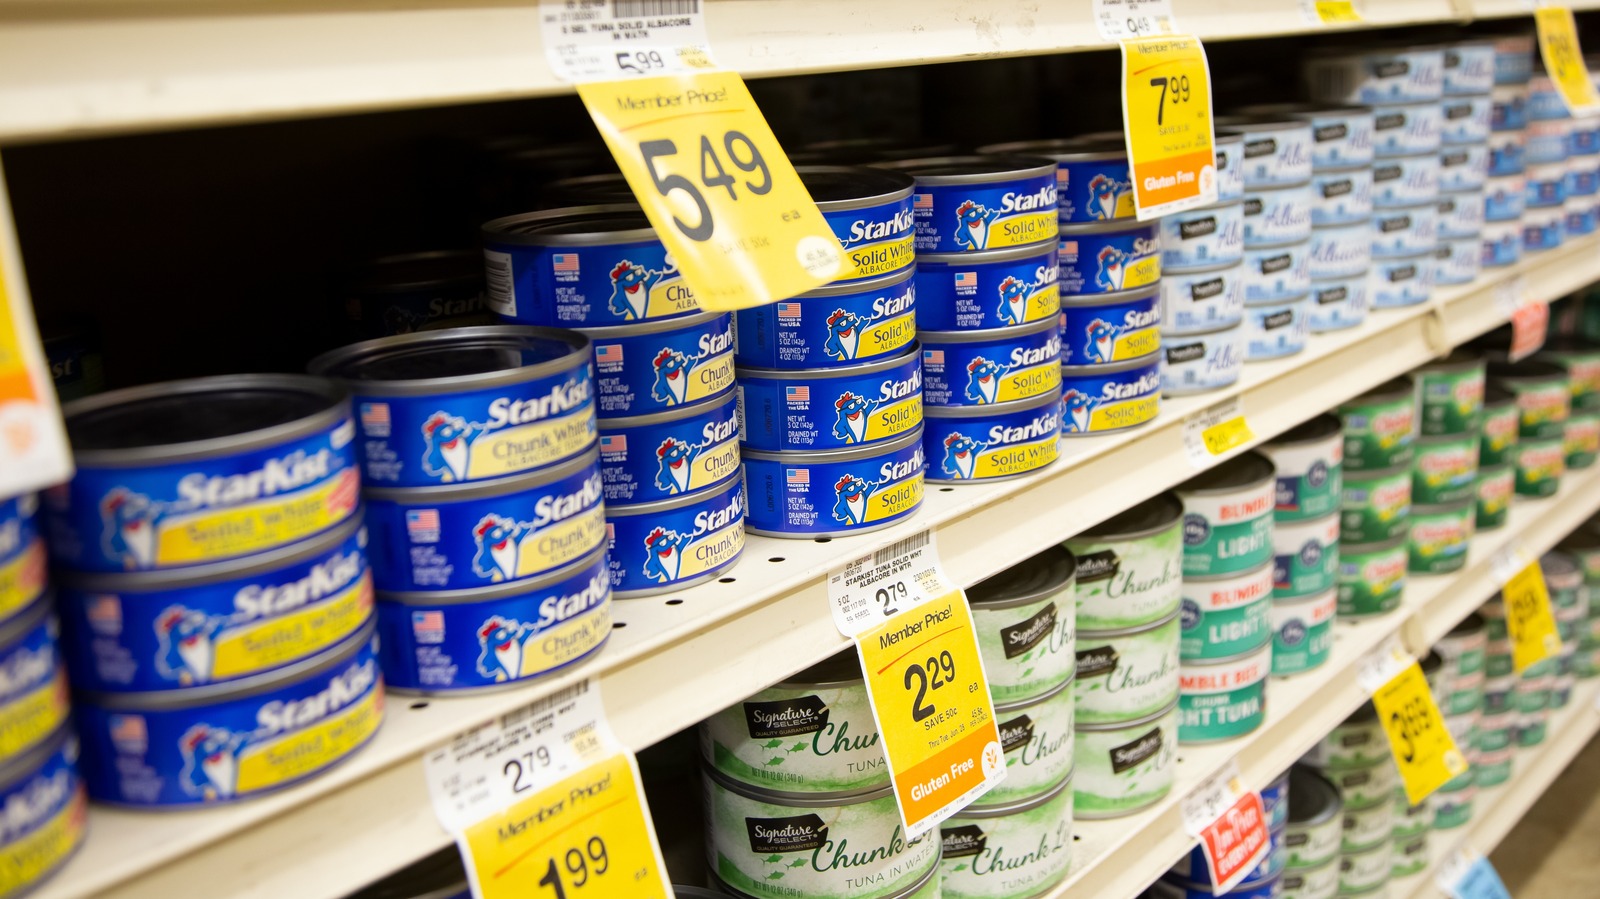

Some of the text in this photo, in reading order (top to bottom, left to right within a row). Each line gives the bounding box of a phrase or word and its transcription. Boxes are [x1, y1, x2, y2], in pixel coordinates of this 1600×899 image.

[648, 18, 691, 28] ALBACORE
[618, 87, 728, 110] Member Price!
[1150, 75, 1190, 125] 799
[639, 130, 773, 242] 549
[1145, 171, 1194, 191] Gluten Free
[781, 209, 801, 222] ea
[1004, 222, 1035, 236] Solid
[1011, 232, 1044, 243] ALBACORE
[853, 250, 887, 267] Solid
[891, 242, 912, 258] White
[859, 261, 898, 275] ALBACORE
[429, 291, 487, 318] Star
[666, 287, 693, 301] Chu
[871, 285, 915, 319] StarKi
[1124, 304, 1160, 330] StarK
[698, 323, 733, 358] Star
[874, 329, 901, 343] Solid
[880, 333, 909, 350] ALBACORE
[1009, 335, 1061, 368] StarKi
[700, 366, 730, 385] Chunk
[1013, 375, 1041, 389] Solid
[1019, 383, 1049, 395] ALBACORE
[1101, 373, 1159, 402] StarKist
[488, 378, 587, 428] StarKist
[1105, 408, 1135, 420] Solid
[702, 409, 738, 448] Star
[882, 409, 909, 426] Solid
[888, 418, 917, 433] ALBACORE
[987, 411, 1058, 445] StarKist
[492, 422, 585, 460] Chunk White
[705, 451, 734, 471] Chunk
[991, 444, 1054, 466] Solid White
[178, 447, 328, 504] StarKist
[998, 461, 1037, 473] ALBACORE
[882, 490, 909, 507] Solid
[693, 490, 743, 536] StarK
[538, 529, 583, 555] Chunk
[696, 538, 732, 561] Chunk
[705, 545, 737, 566] ALBACORE
[845, 550, 922, 586] STARKIST TUNA SOLID WHT
[859, 571, 890, 588] ALBACORE
[899, 562, 912, 571] WTR
[233, 551, 359, 617] StarKist
[1107, 568, 1172, 598] Chunk
[842, 595, 850, 604] OZ
[876, 581, 908, 616] 279
[880, 605, 952, 650] Member Price!
[1009, 612, 1051, 645] Signature
[1050, 616, 1075, 653] Chu
[543, 630, 590, 656] Chunk
[904, 650, 955, 722] 229
[969, 682, 978, 693] ea
[1106, 664, 1171, 692] Chunk
[1179, 674, 1228, 689] MBLE
[256, 658, 375, 730] StarKist
[1192, 695, 1230, 706] CHUNK
[753, 708, 814, 728] Signature
[773, 717, 813, 728] SELECT
[925, 714, 944, 731] SAVE
[1176, 696, 1259, 727] GHT TUNA
[755, 725, 819, 737] QUALITY GUARANTEED
[812, 721, 880, 755] Chun
[929, 739, 940, 749] Thru
[504, 746, 550, 793] 279
[752, 768, 761, 777] NET
[847, 756, 885, 773] TUNA
[911, 772, 950, 801] Gluten
[951, 758, 974, 779] Free
[498, 773, 612, 840] Member Price!
[755, 825, 812, 843] Signature
[774, 834, 812, 843] SELECT
[779, 841, 818, 850] GUARANTEED
[812, 824, 904, 872] Chunk
[973, 833, 1049, 875] Chunk
[846, 841, 935, 888] TUNA IN WATER
[1001, 874, 1033, 890] TUNA
